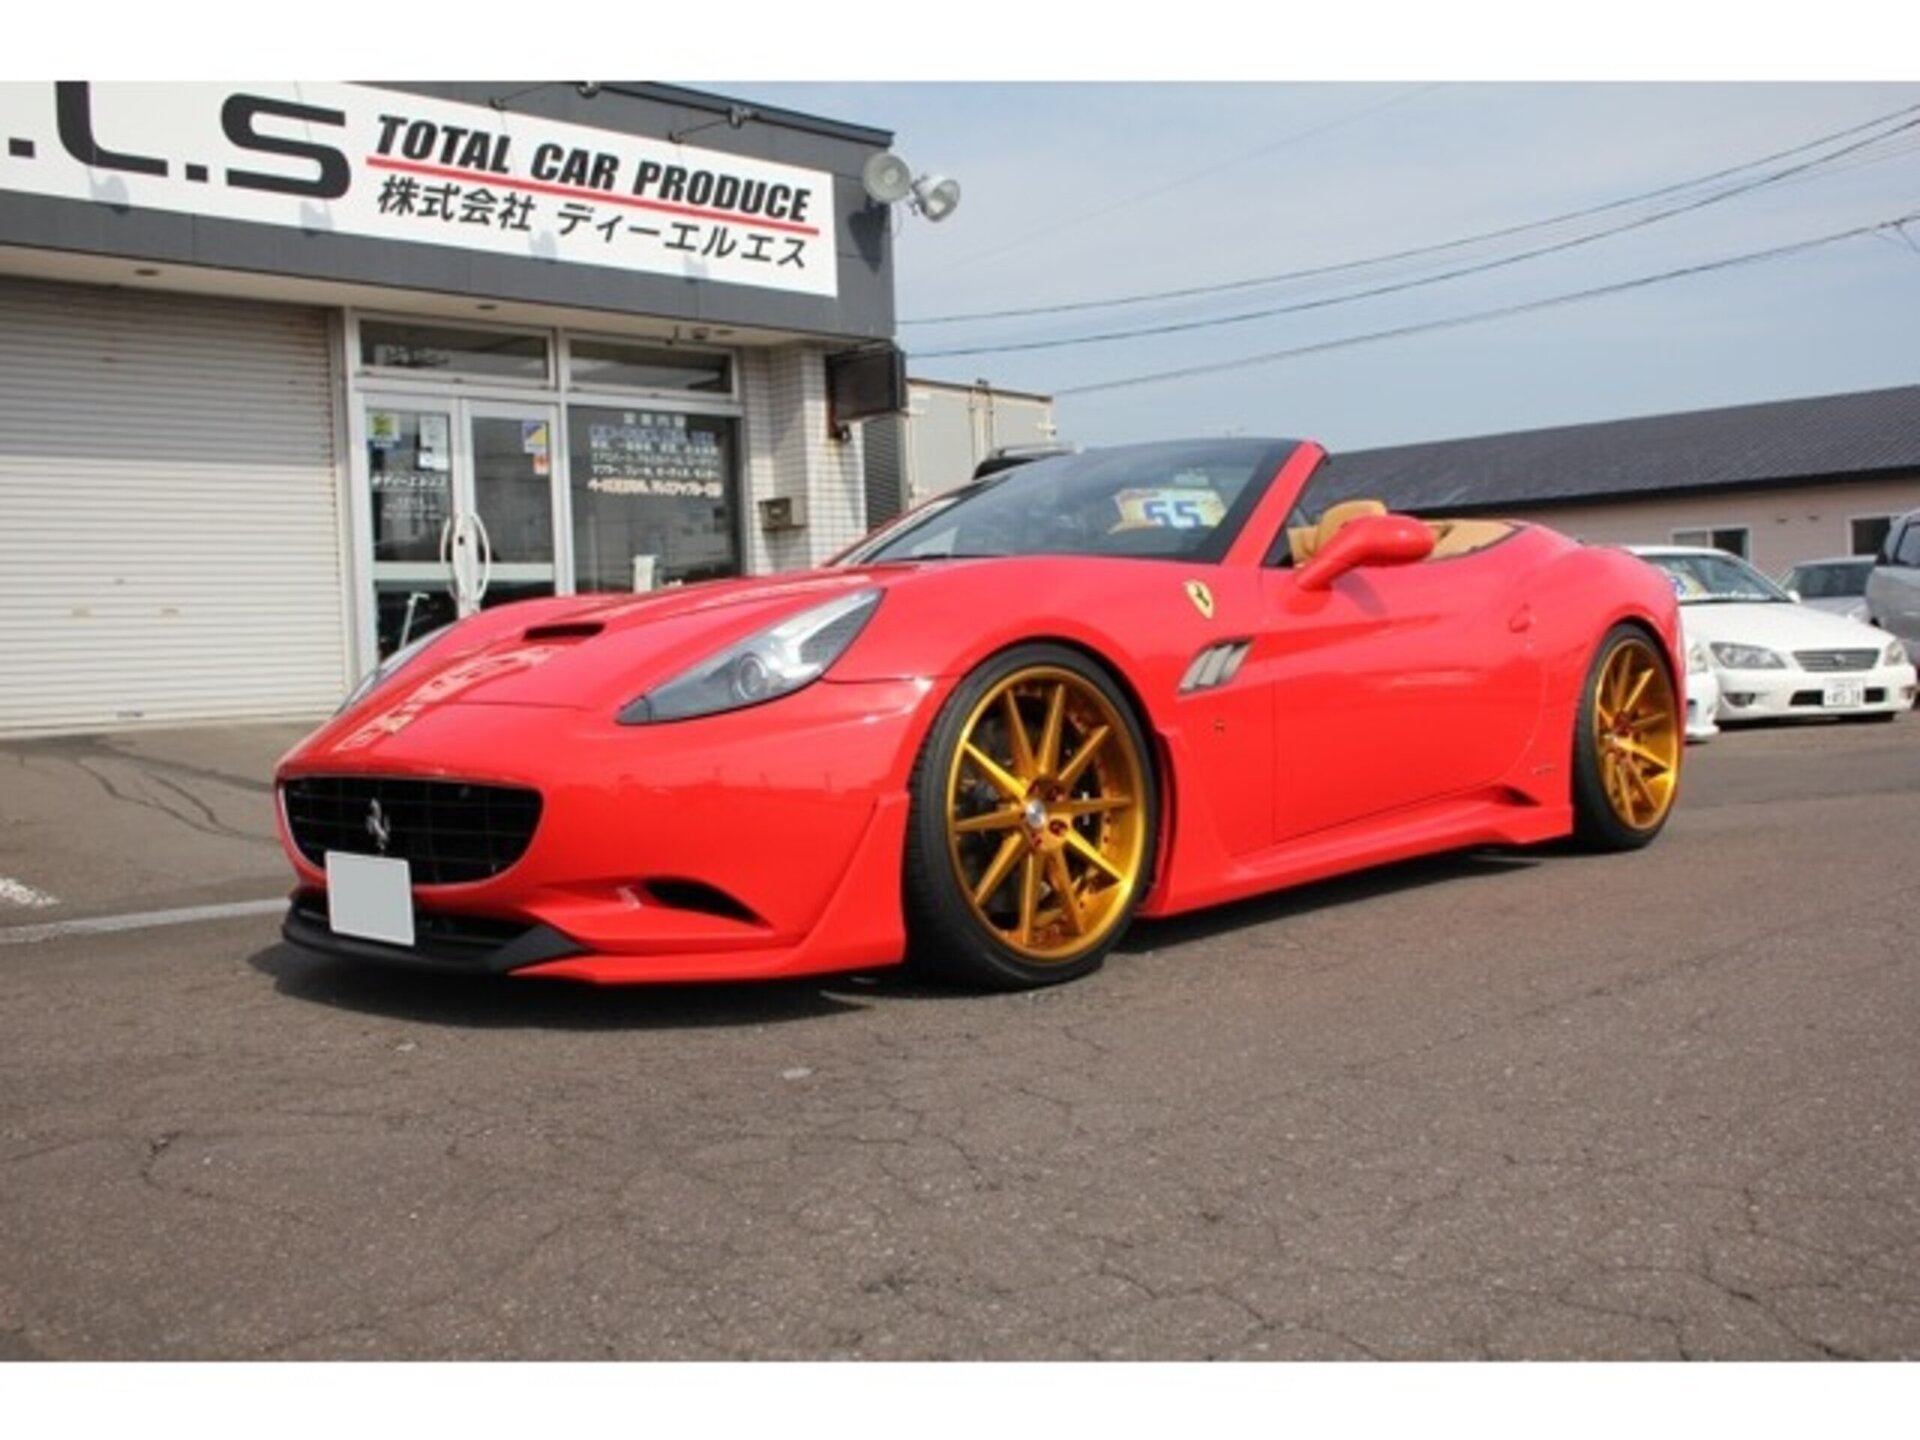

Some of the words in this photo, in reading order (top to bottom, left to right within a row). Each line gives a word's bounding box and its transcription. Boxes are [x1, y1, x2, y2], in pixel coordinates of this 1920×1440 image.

[376, 114, 511, 175] TOTAL
[530, 143, 620, 191] CAR
[632, 160, 812, 222] PRODUCE
[377, 174, 536, 232] 株式会社
[557, 203, 806, 268] ディーエルエス
